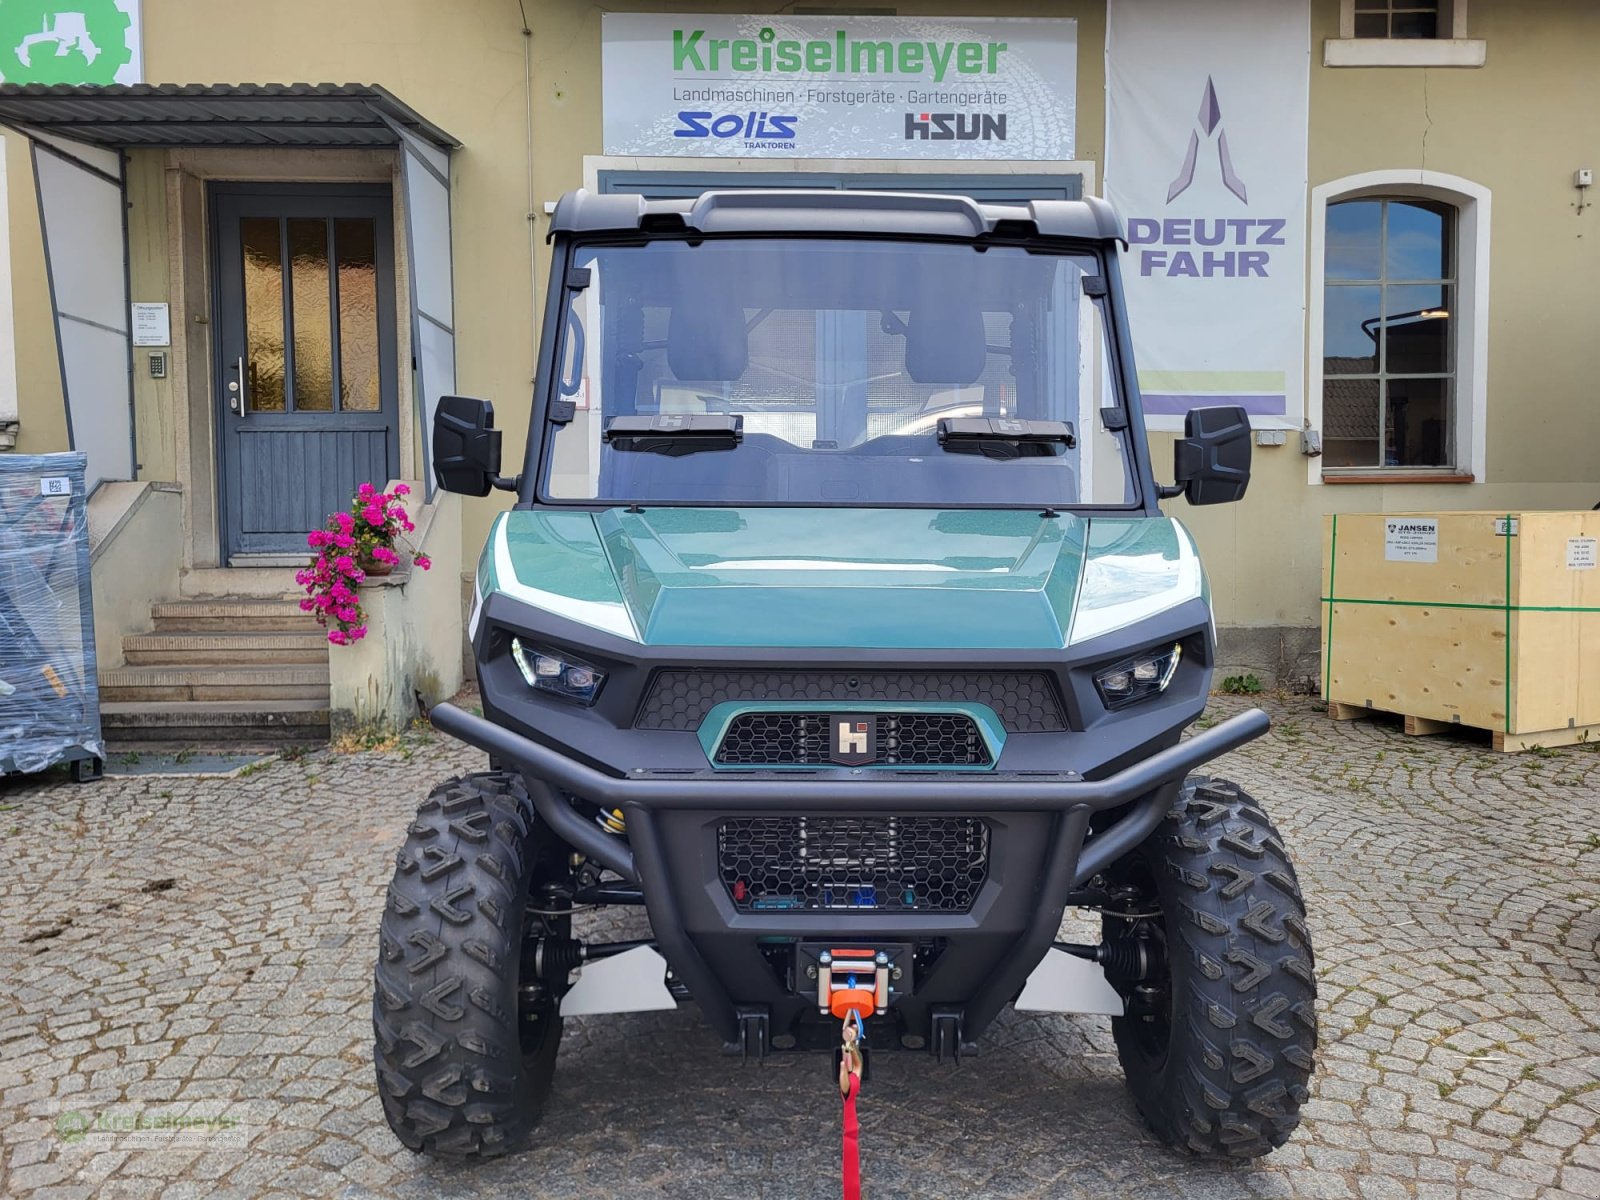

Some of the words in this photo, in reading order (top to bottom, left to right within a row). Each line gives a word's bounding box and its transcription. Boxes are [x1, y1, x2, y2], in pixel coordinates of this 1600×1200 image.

[673, 27, 1008, 83] Kreiselmeyer
[673, 87, 794, 103] Landmaschinen
[807, 89, 895, 106] Forstgeräte
[907, 90, 1007, 107] Gartengeräte
[744, 141, 796, 150] TRAKTOREN
[1127, 217, 1287, 246] DEUTZ
[1140, 250, 1270, 278] FAHR
